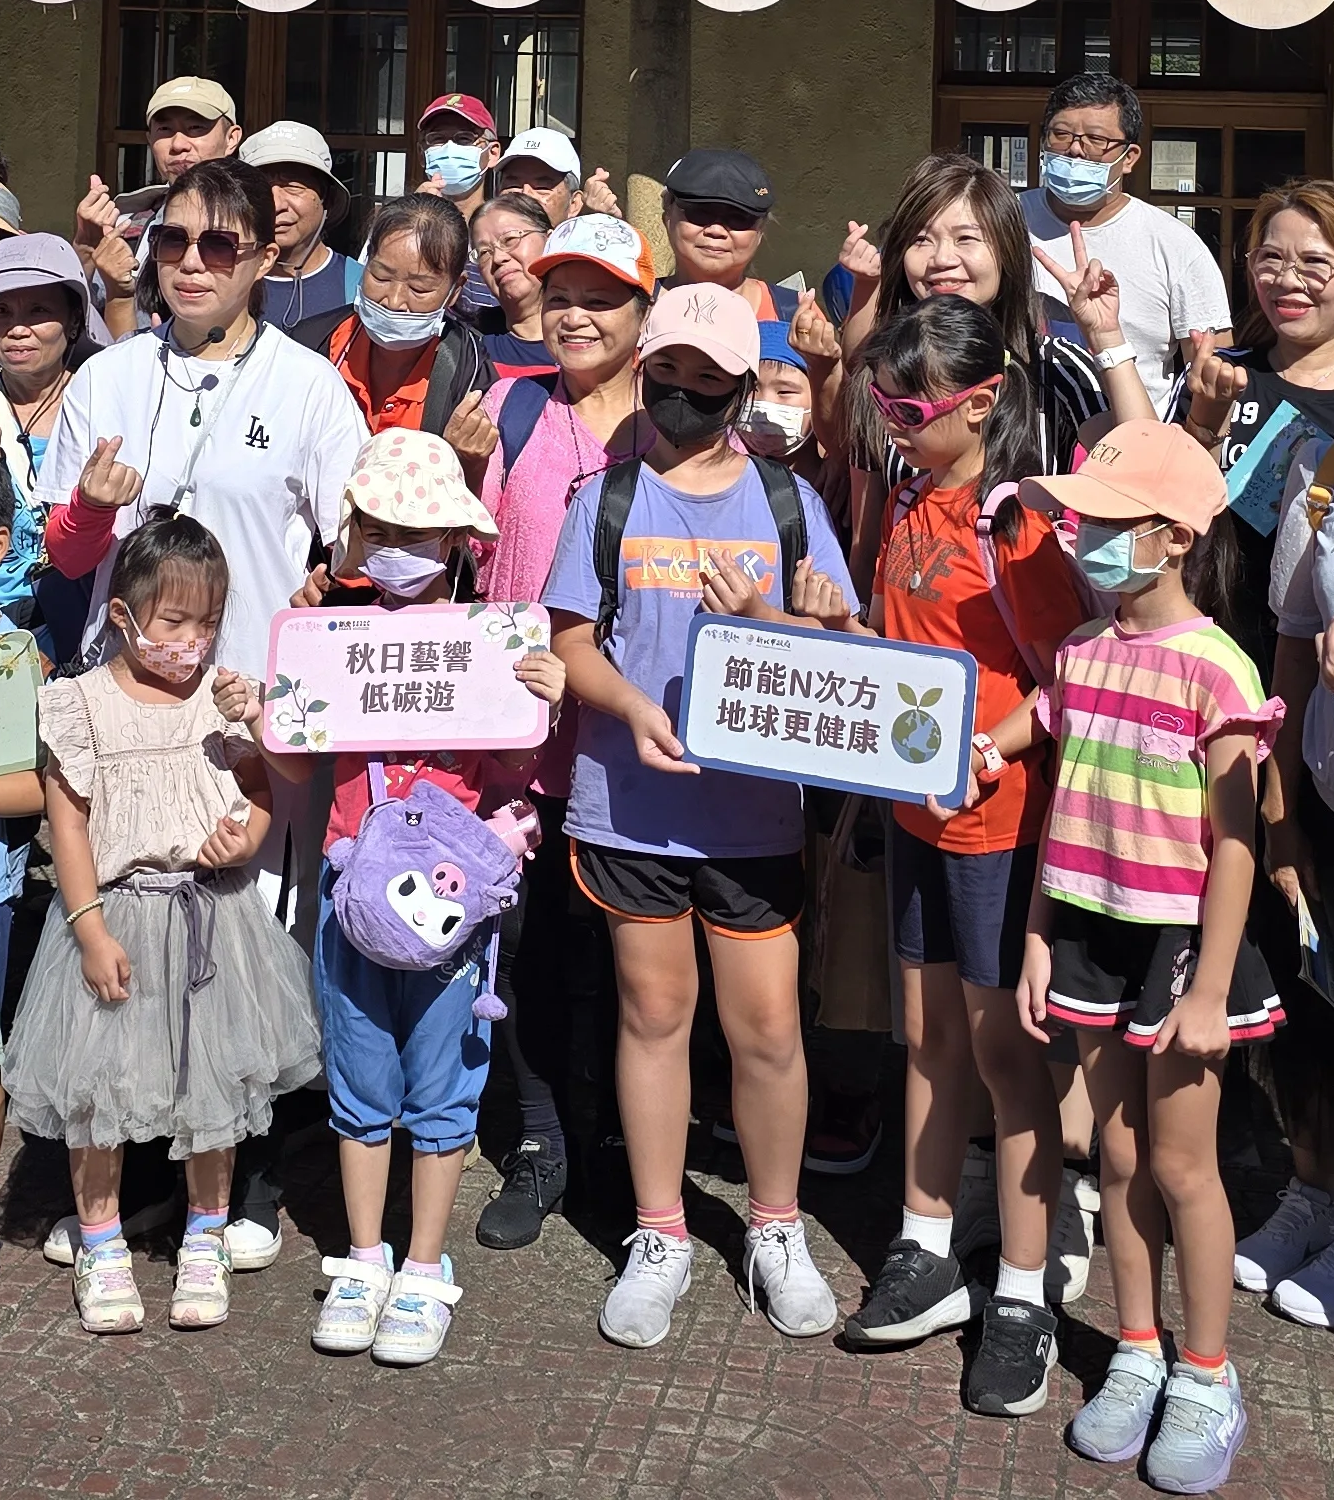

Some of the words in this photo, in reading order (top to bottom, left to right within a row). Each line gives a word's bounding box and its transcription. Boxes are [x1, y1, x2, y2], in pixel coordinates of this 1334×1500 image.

[245, 414, 270, 450] LA
[640, 544, 665, 582] K
[667, 546, 693, 584] &
[345, 640, 474, 675] 秋日藝響
[359, 680, 456, 715] 低碳遊
[723, 655, 881, 711] 節能N次方
[716, 697, 882, 755] 地球更健康
